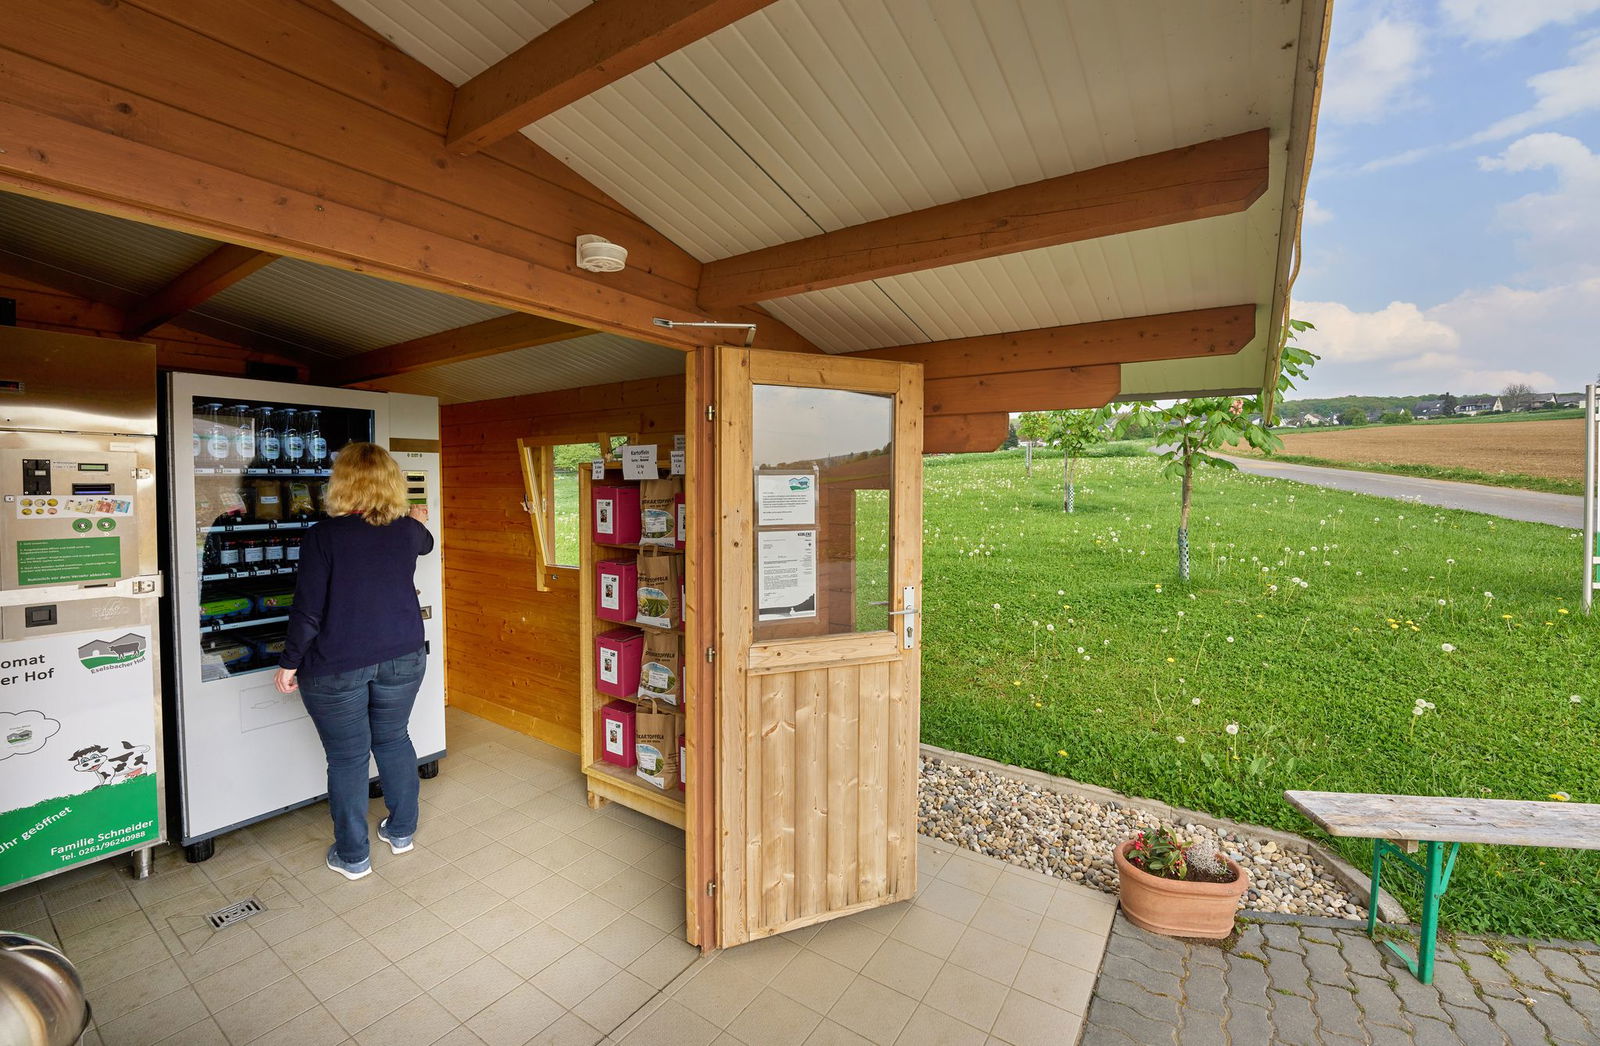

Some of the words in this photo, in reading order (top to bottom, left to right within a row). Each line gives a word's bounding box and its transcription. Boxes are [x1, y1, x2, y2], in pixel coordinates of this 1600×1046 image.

[1, 654, 46, 669] omat
[90, 661, 133, 674] Eselsbacher
[133, 656, 146, 665] Hof
[0, 675, 19, 686] er
[25, 667, 55, 682] Hof
[21, 805, 73, 841] geöffnet
[50, 837, 95, 857] Familie
[97, 819, 154, 842] Schneider
[60, 852, 77, 862] Tel.
[78, 830, 147, 857] 0261/96240988
